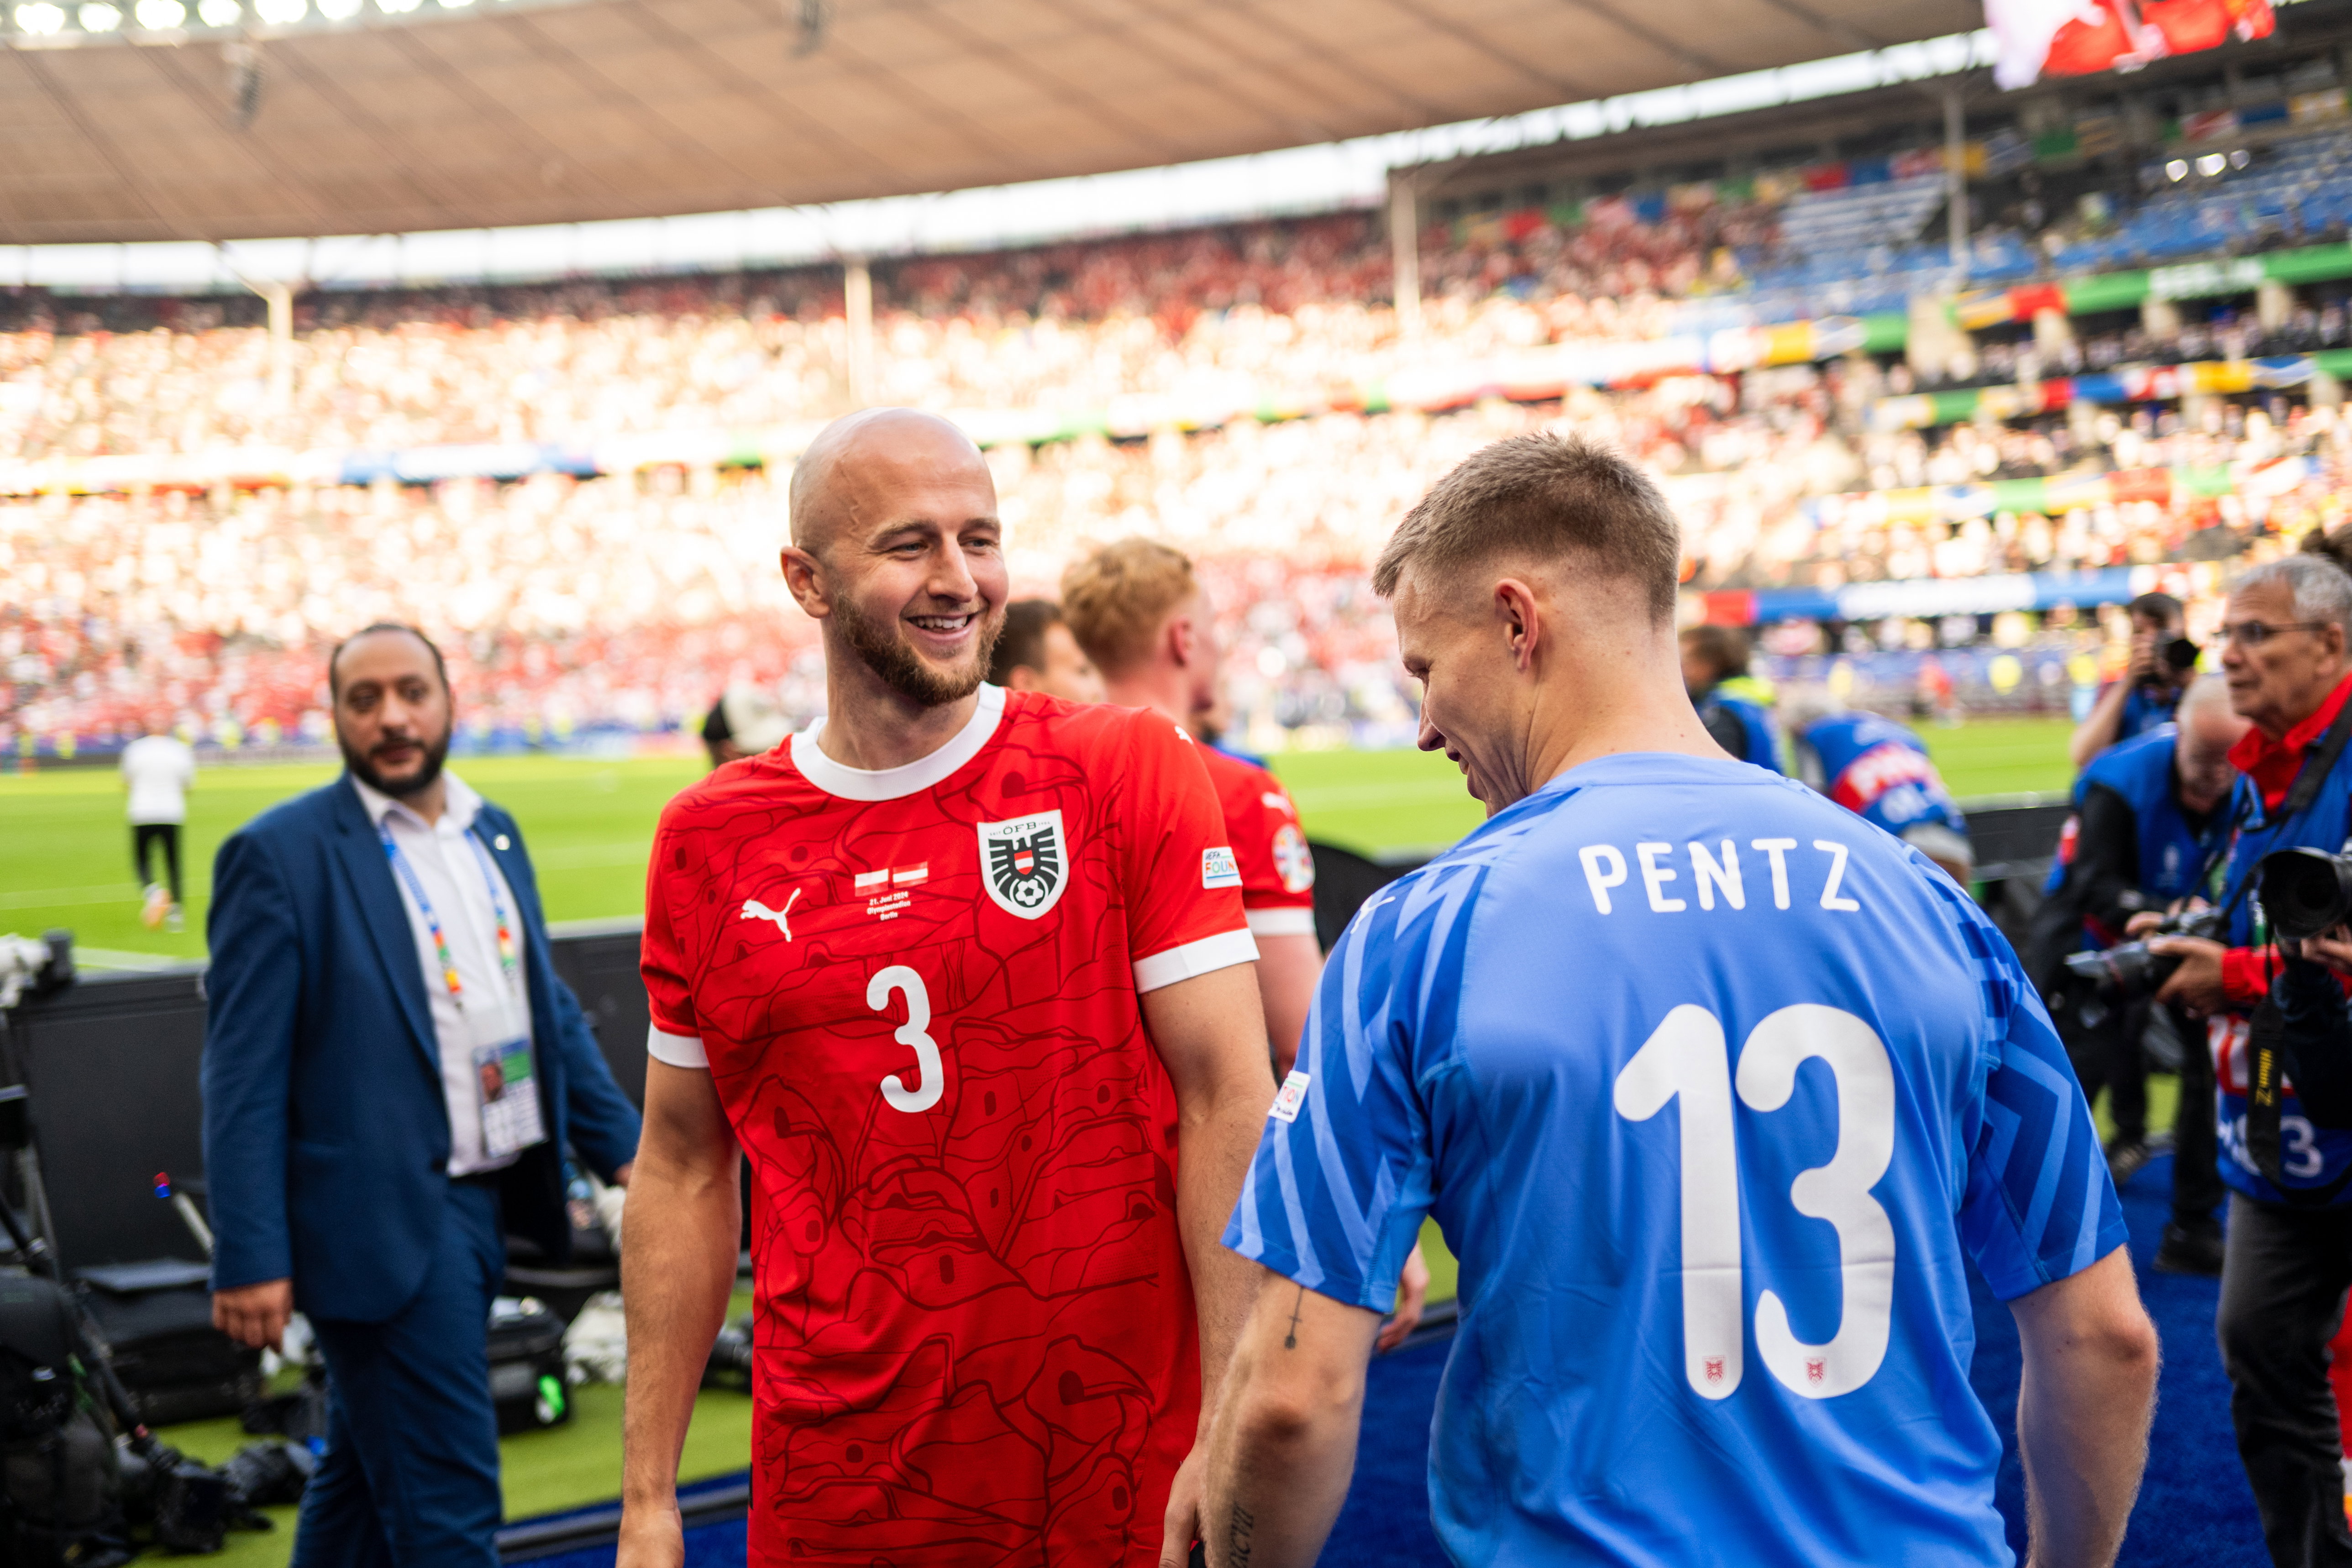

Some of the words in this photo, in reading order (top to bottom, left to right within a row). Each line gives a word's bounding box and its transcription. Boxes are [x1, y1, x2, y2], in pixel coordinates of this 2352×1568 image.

[1003, 821, 1036, 835] ÖFB
[1205, 851, 1220, 860] UEFA
[1578, 838, 1860, 915] PENTZ
[880, 895, 892, 903] Juni
[893, 891, 908, 900] 2024
[866, 901, 911, 915] Olympiastadion
[880, 912, 898, 921] Berlin
[866, 965, 944, 1112] 3
[1614, 1003, 1896, 1400] 13
